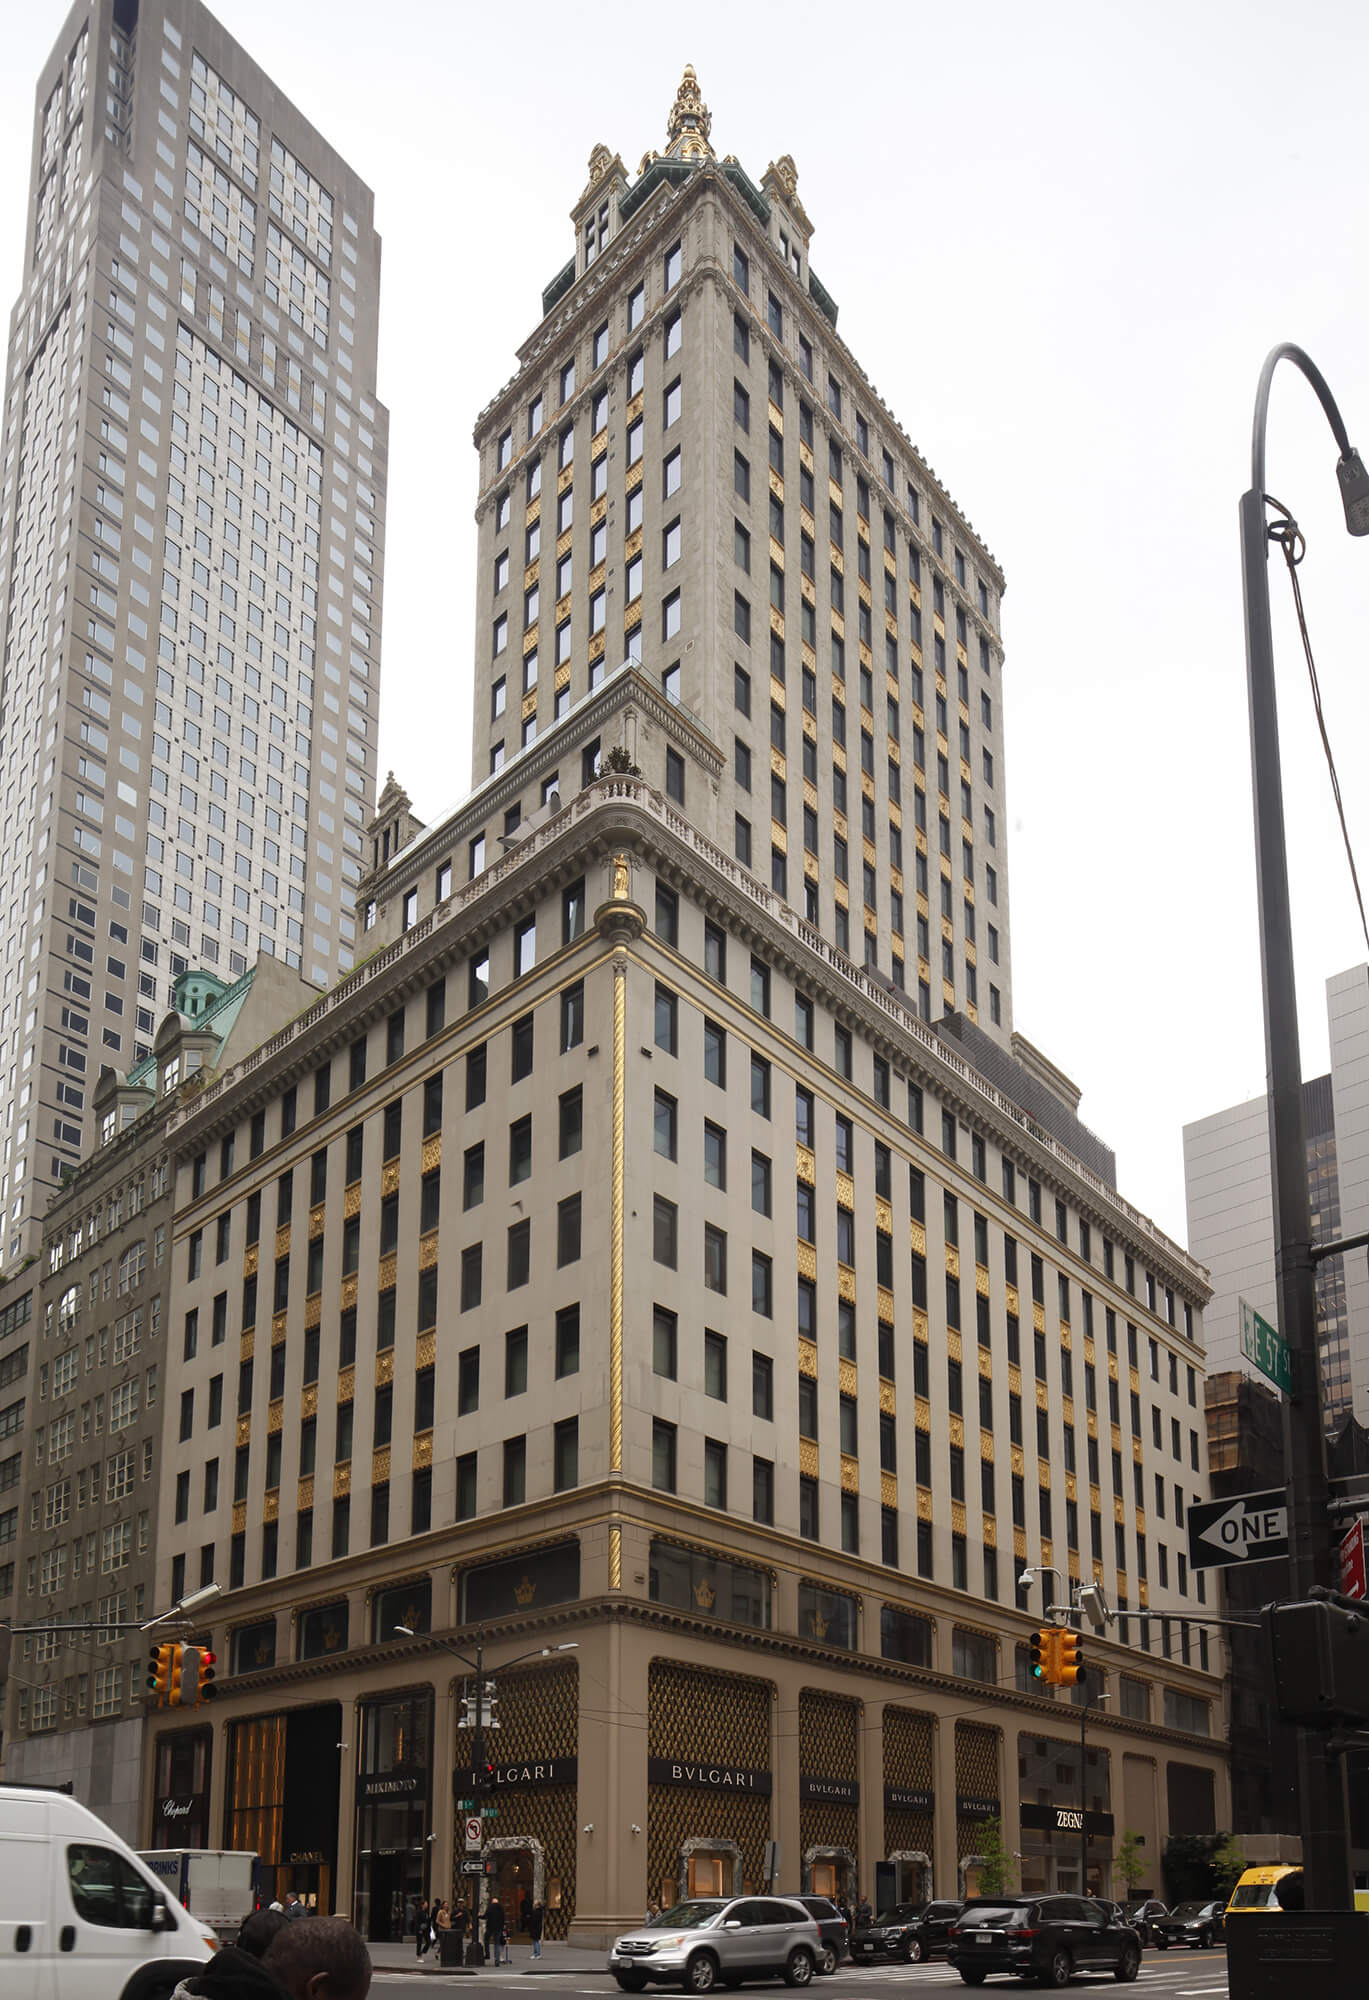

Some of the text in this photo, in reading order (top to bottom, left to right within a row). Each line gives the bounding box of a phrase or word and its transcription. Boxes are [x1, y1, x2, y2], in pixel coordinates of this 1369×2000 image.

[1255, 1320, 1262, 1361] E
[1266, 1332, 1279, 1377] 57
[1221, 1511, 1281, 1544] ONE
[672, 1765, 753, 1787] BVLGARI
[809, 1783, 851, 1796] BVLGARI
[891, 1793, 928, 1805] BVLGARI
[162, 1799, 193, 1819] Chopard
[962, 1801, 995, 1812] BVLGARI
